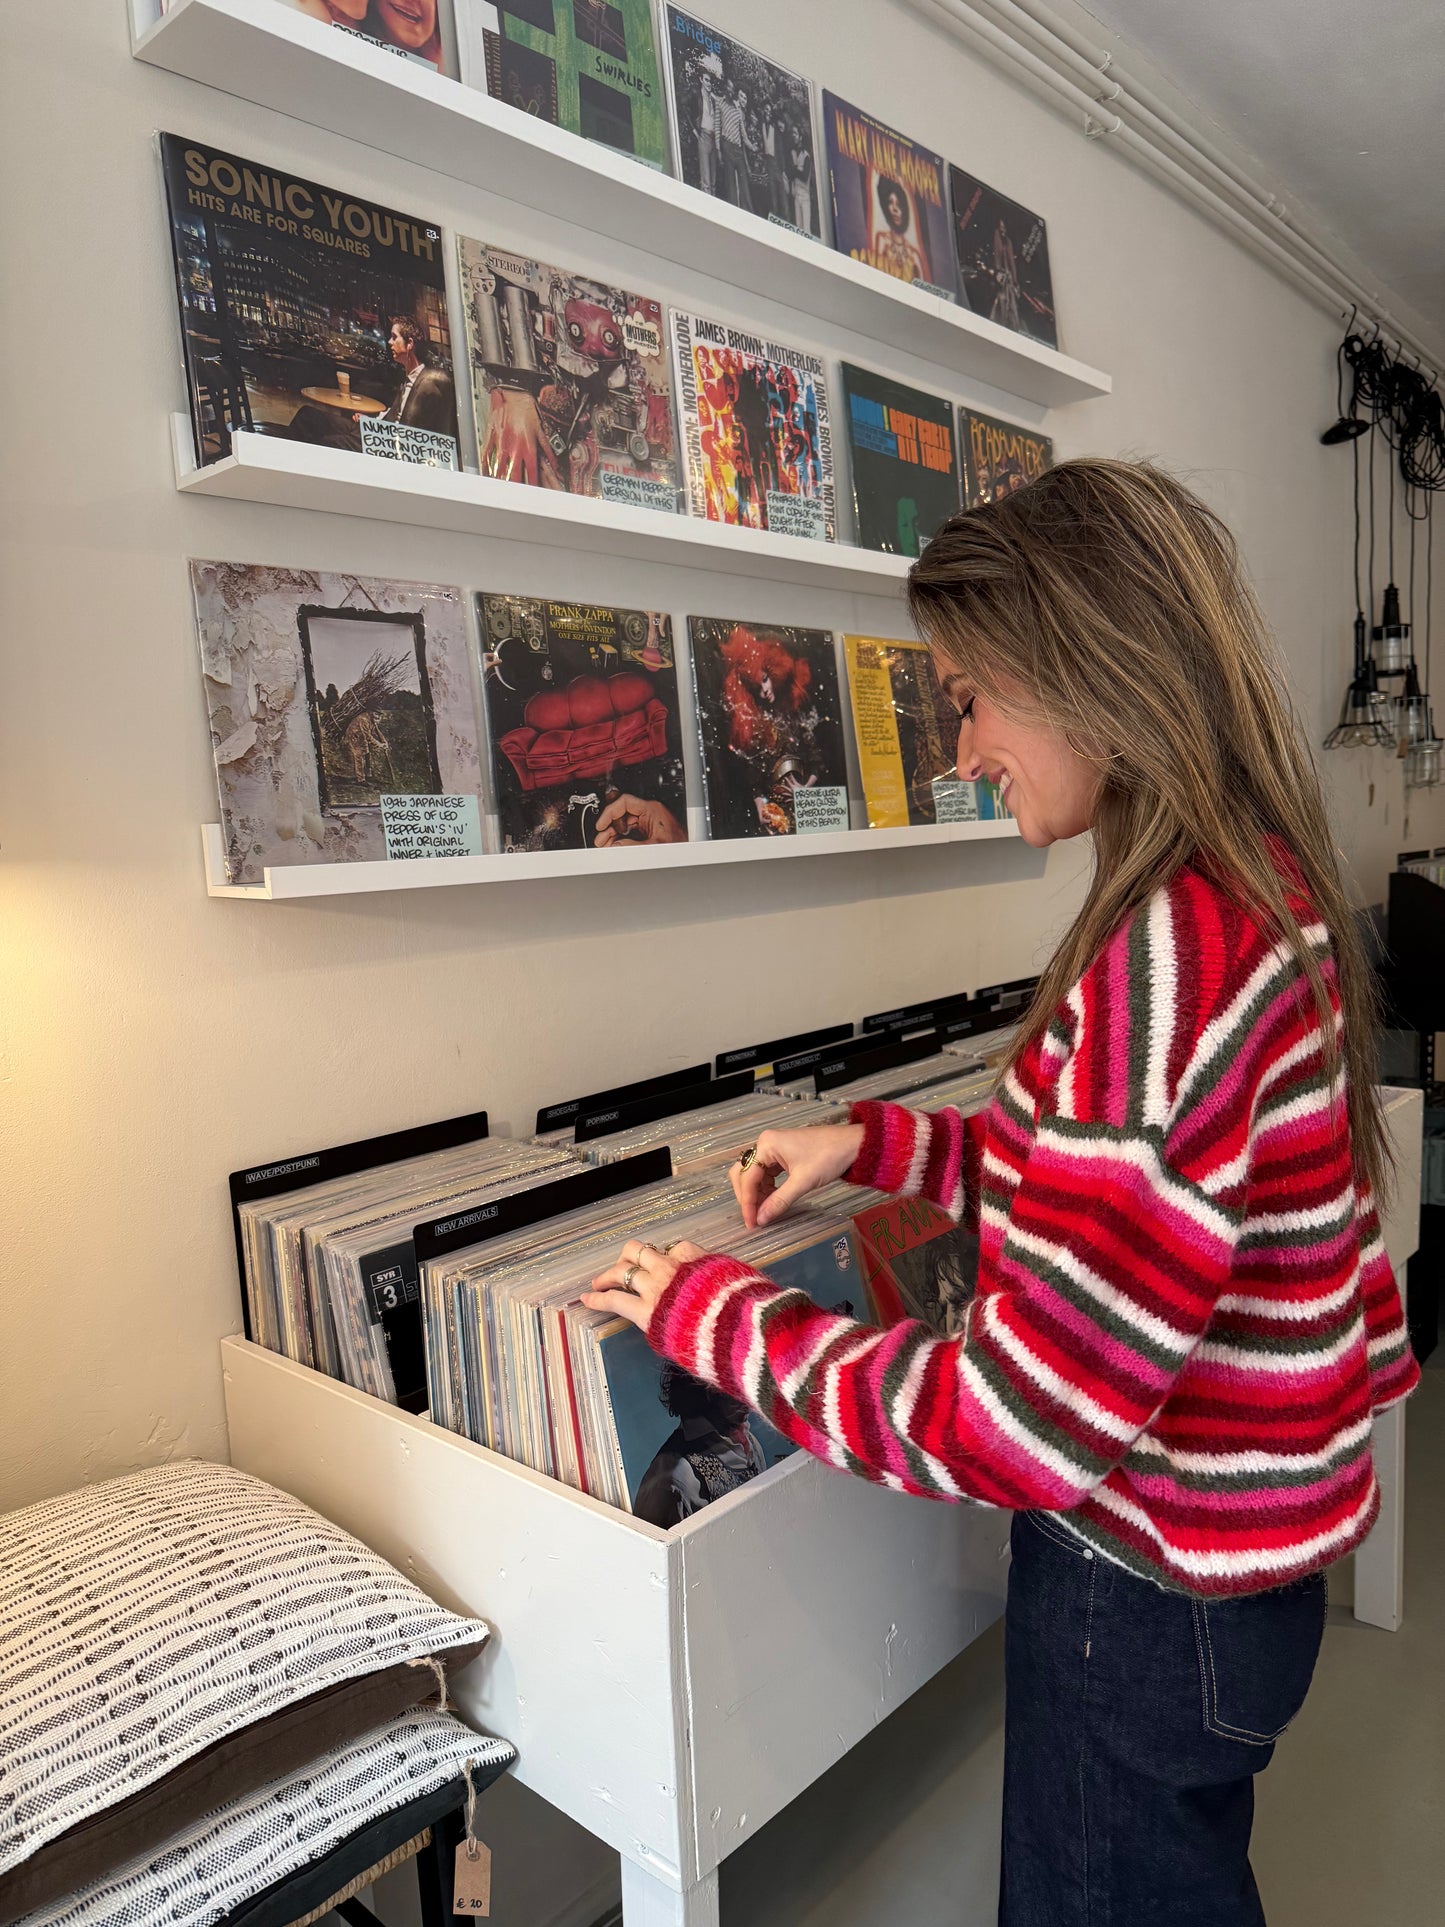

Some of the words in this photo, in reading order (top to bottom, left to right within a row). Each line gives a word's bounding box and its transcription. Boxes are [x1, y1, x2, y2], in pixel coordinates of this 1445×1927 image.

[675, 14, 722, 54] Bridge
[595, 56, 651, 98] SWIRLIES
[184, 150, 314, 220] SONIC
[321, 193, 434, 262] YOUTH
[188, 188, 226, 214] HITS
[230, 202, 262, 225] ARE
[267, 212, 298, 236] FOR
[302, 224, 370, 258] SQUARES
[488, 254, 526, 276] STEREO
[695, 318, 726, 346] JAMES
[728, 331, 765, 358] BROWN:
[766, 342, 824, 376] MOTHERLODE
[676, 312, 698, 416] MOTHERLODE
[814, 378, 829, 424] JAMES
[362, 420, 430, 444] NUMBERED
[430, 435, 456, 450] FIRST
[412, 444, 426, 457] OF
[819, 425, 833, 480] BROWN:
[603, 474, 640, 489] GERMAN
[549, 604, 583, 619] FRANK
[585, 608, 614, 622] ZAPPA
[550, 621, 579, 631] MOTHERS
[410, 797, 466, 808] JAPANESE
[384, 810, 421, 822] PRESS
[424, 810, 438, 820] OF
[439, 811, 458, 821] LED
[388, 837, 414, 848] WITH
[416, 836, 464, 846] ORIGINAL
[426, 850, 432, 858] +
[548, 1104, 578, 1118] SHOEGAZE
[587, 1112, 618, 1126] POP/ROCK
[248, 1158, 318, 1182] WAVE/POSTPUNK
[437, 1221, 456, 1234] NEW
[457, 1207, 496, 1227] ARRIVALS
[377, 1270, 396, 1283] SYR
[383, 1285, 398, 1308] 3
[456, 1898, 466, 1908] €
[470, 1899, 482, 1908] 20
